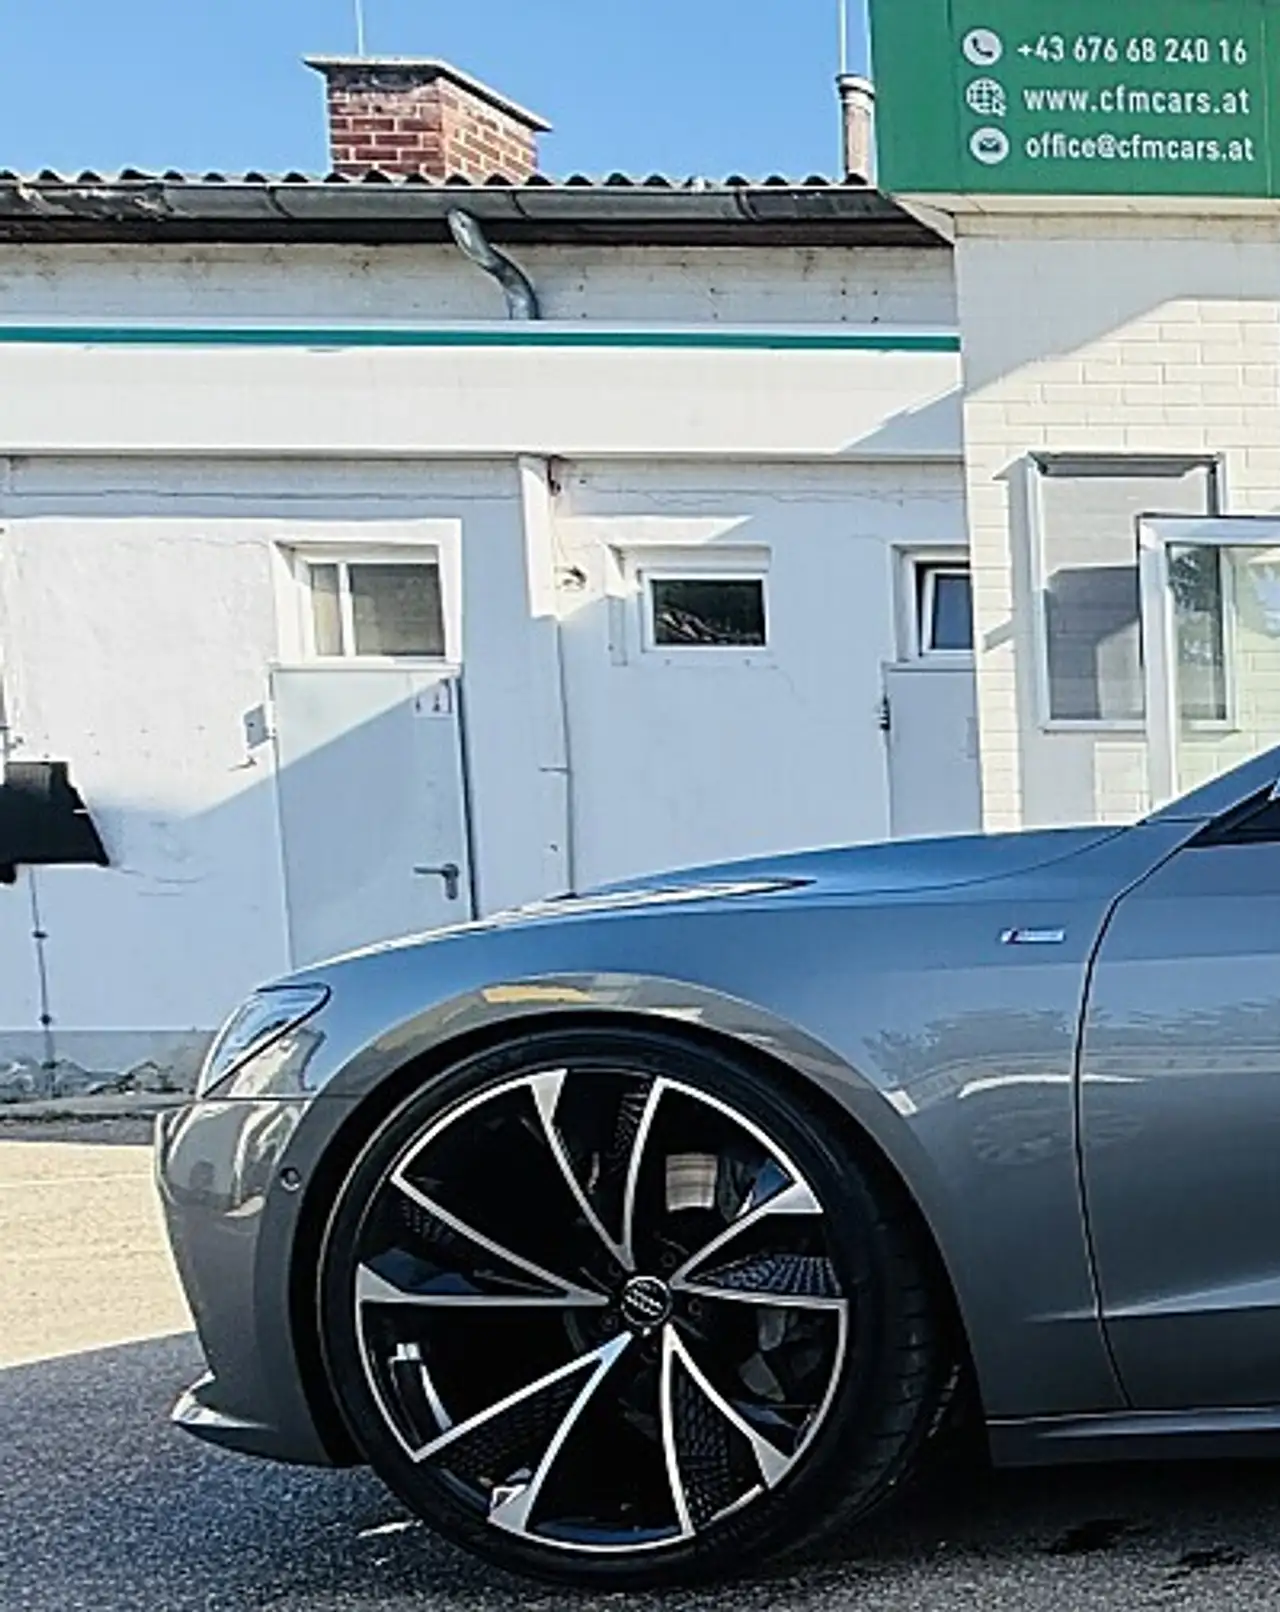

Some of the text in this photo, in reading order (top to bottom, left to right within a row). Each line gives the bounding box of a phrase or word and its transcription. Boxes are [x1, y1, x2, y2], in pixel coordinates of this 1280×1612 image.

[1016, 35, 1248, 65] +43 676 68 240 16
[1023, 84, 1251, 115] www.cfmcars.at
[1024, 131, 1255, 162] office@cfmcars.at
